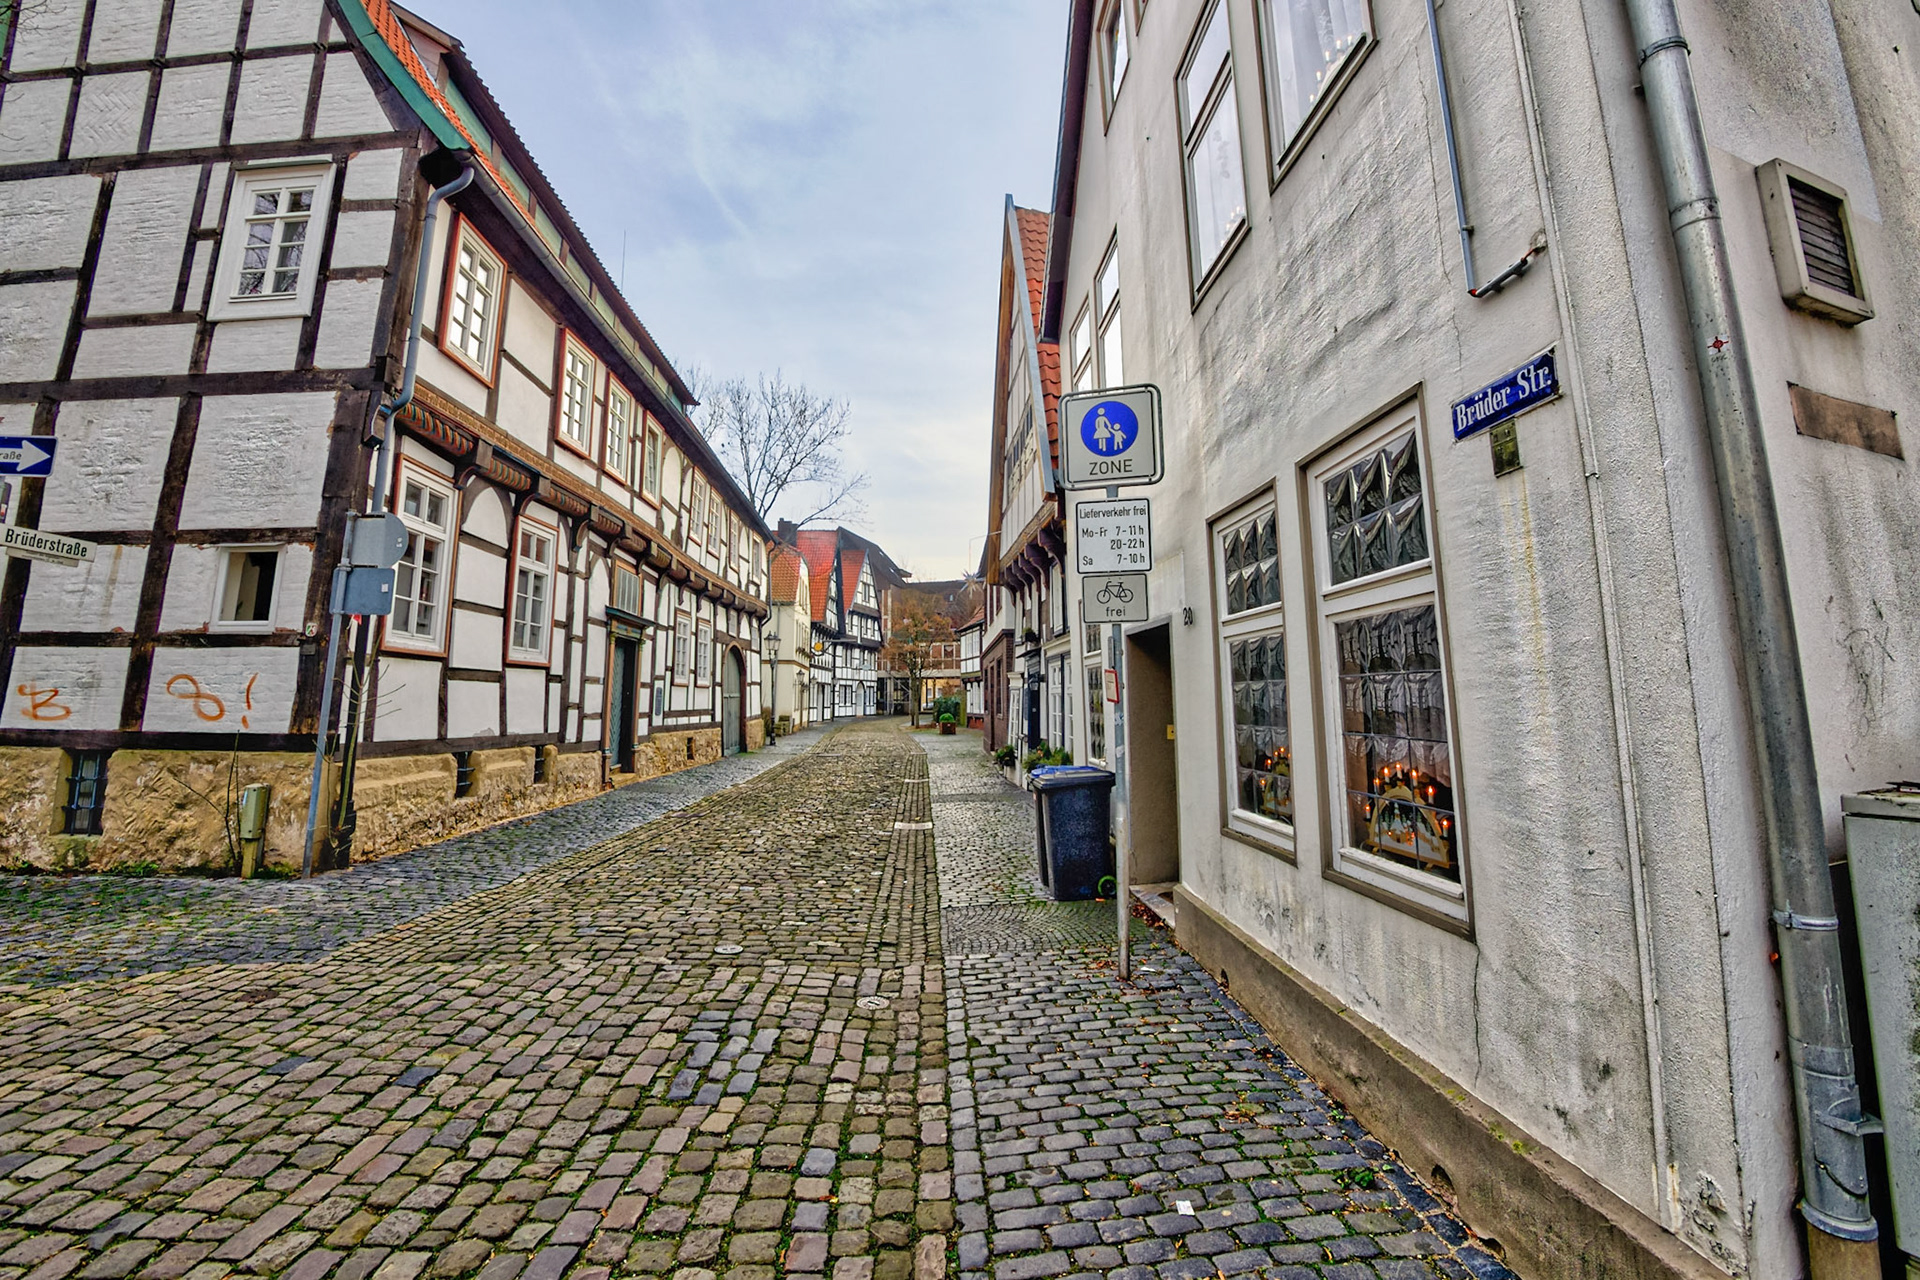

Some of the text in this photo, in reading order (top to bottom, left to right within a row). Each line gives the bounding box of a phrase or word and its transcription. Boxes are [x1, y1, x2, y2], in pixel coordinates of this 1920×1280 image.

[1455, 364, 1552, 431] Brüder Str.
[1089, 458, 1133, 476] ZONE
[1079, 505, 1147, 519] Lieferverkehr frei
[4, 528, 88, 558] Brüderstraße
[1082, 555, 1094, 566] Sa
[1105, 605, 1126, 617] frei
[1183, 606, 1193, 626] 20
